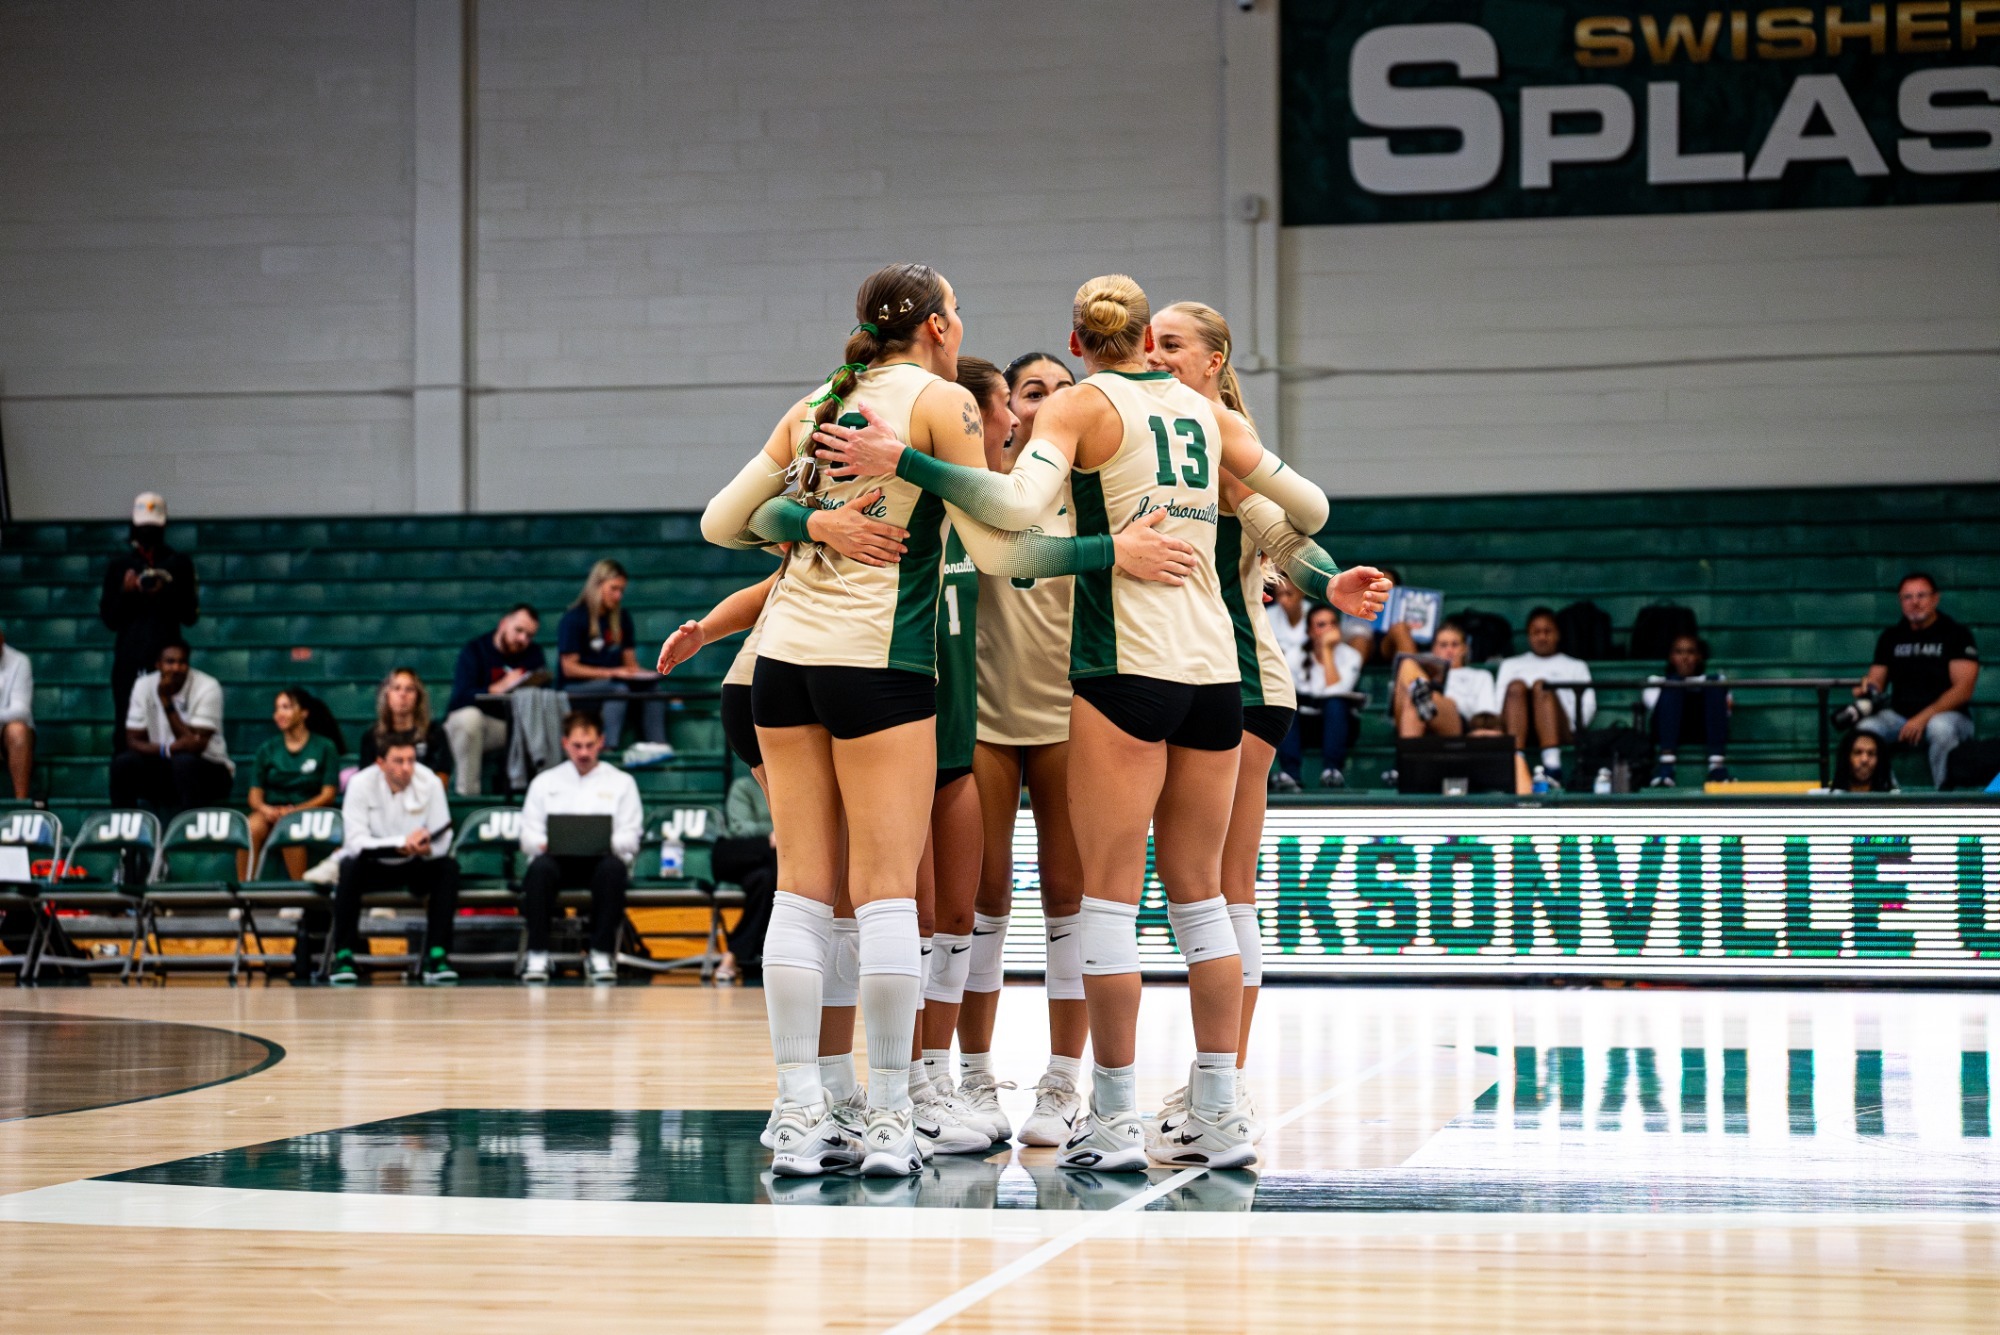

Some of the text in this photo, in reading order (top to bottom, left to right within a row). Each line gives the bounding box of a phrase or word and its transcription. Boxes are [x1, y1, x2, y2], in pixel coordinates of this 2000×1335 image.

[1147, 414, 1209, 489] 13
[944, 584, 961, 636] 1
[1, 814, 44, 842] JU
[99, 812, 143, 840] JU
[185, 811, 231, 840] JU
[289, 811, 335, 840] JU
[479, 811, 523, 840] JU
[662, 809, 706, 838] JU
